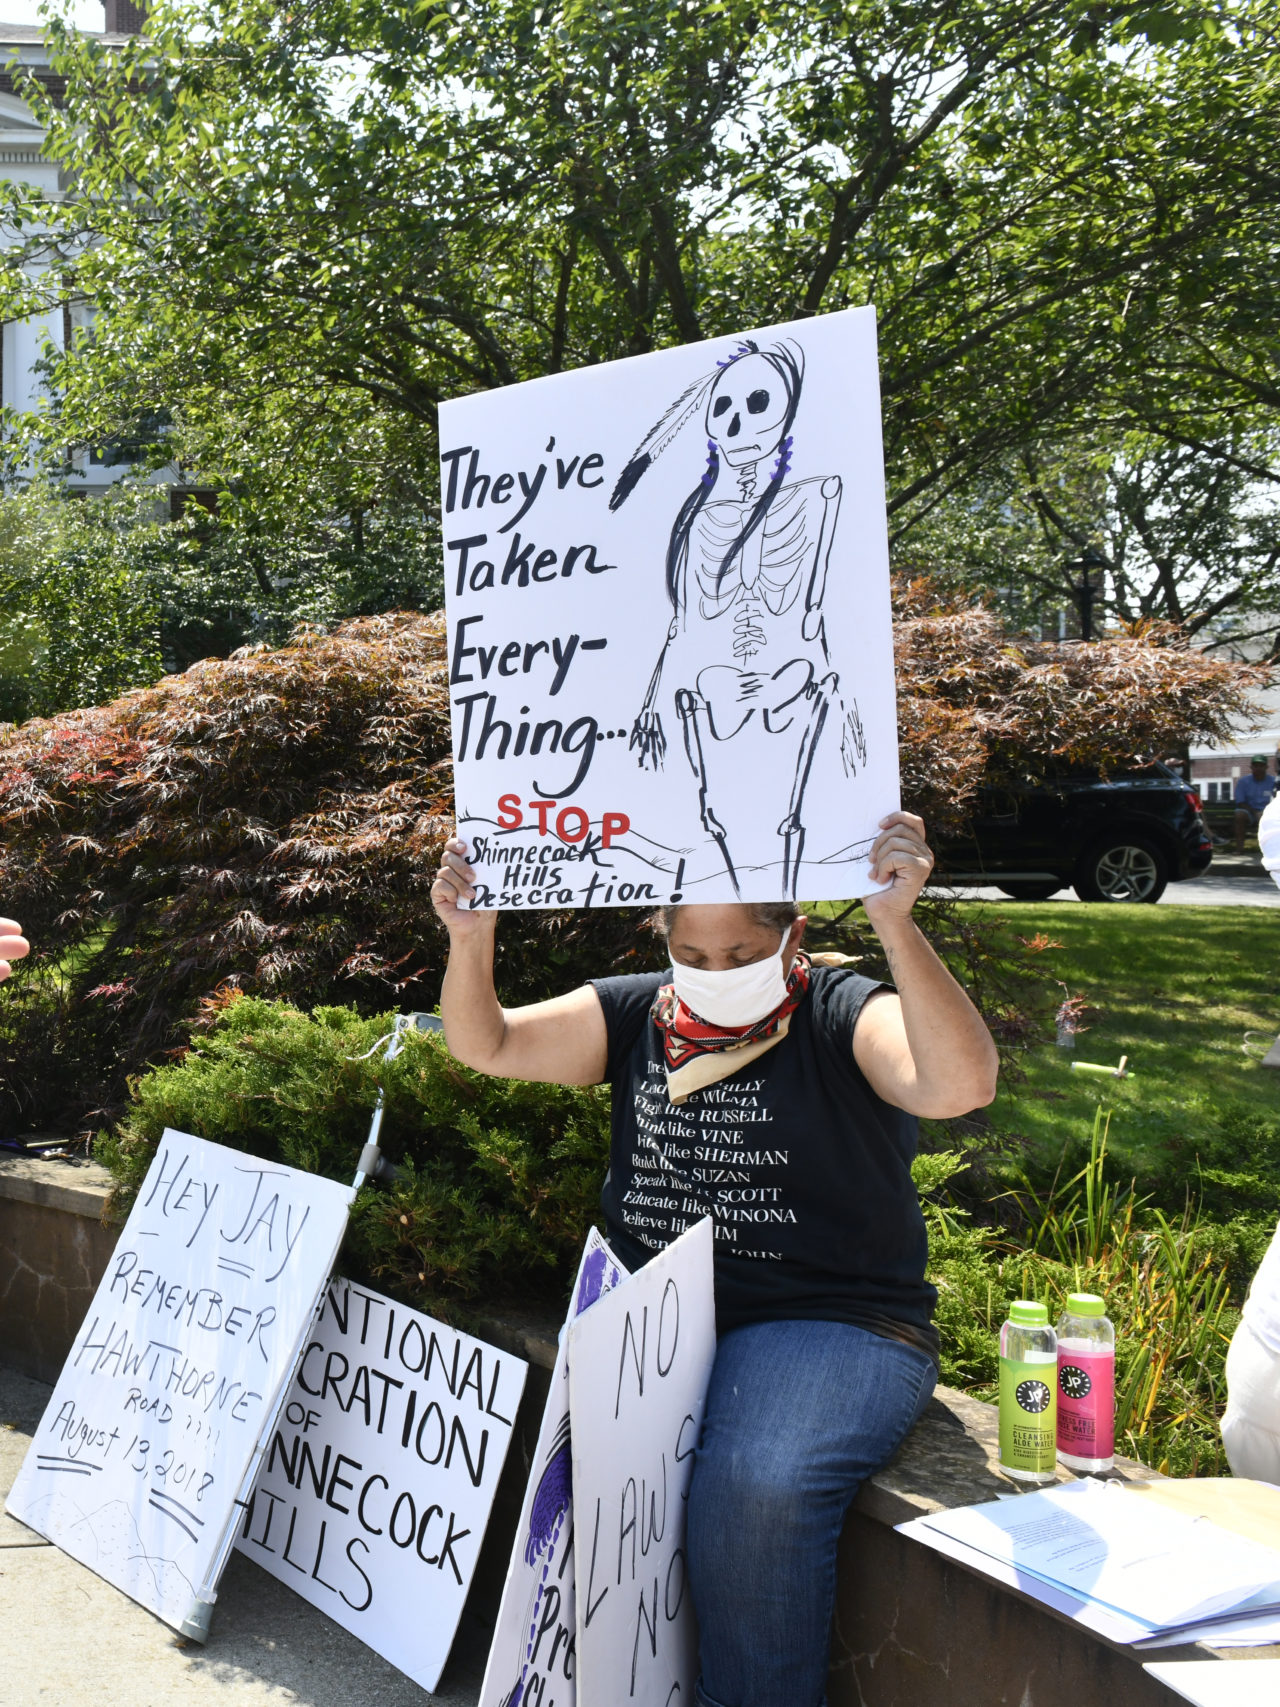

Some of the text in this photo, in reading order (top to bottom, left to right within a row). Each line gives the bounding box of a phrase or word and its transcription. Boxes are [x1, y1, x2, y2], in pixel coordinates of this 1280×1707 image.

[440, 435, 605, 534] They've
[447, 532, 618, 596] Taken
[450, 615, 608, 697] Every-
[453, 691, 627, 799] Thing...
[497, 793, 631, 849] STOP
[464, 831, 615, 867] Shinnecock
[503, 864, 564, 891] Hills
[720, 1079, 767, 1092] ILLY
[635, 1114, 744, 1145] hink like VINE
[665, 1103, 695, 1121] like
[699, 1108, 773, 1124] RUSSELL
[663, 1142, 691, 1159] like
[694, 1145, 789, 1165] SHERMAN
[630, 1172, 668, 1189] Speak
[717, 1187, 782, 1204] SCOTT
[691, 1167, 751, 1183] SUZAN
[144, 1148, 311, 1283] HEY JAY
[622, 1190, 679, 1210] Educate
[682, 1197, 712, 1216] like
[713, 1203, 798, 1224] WINONA
[109, 1251, 277, 1364] REMEMBER
[615, 1277, 680, 1420] NO
[73, 1317, 263, 1423] HAWTHORNE
[1066, 1375, 1082, 1389] JP
[124, 1387, 173, 1424] ROAD
[296, 1341, 489, 1488] CRATION
[1027, 1390, 1043, 1404] JP
[50, 1400, 120, 1458] August
[285, 1401, 322, 1432] OF
[266, 1430, 473, 1586] NNECOCK
